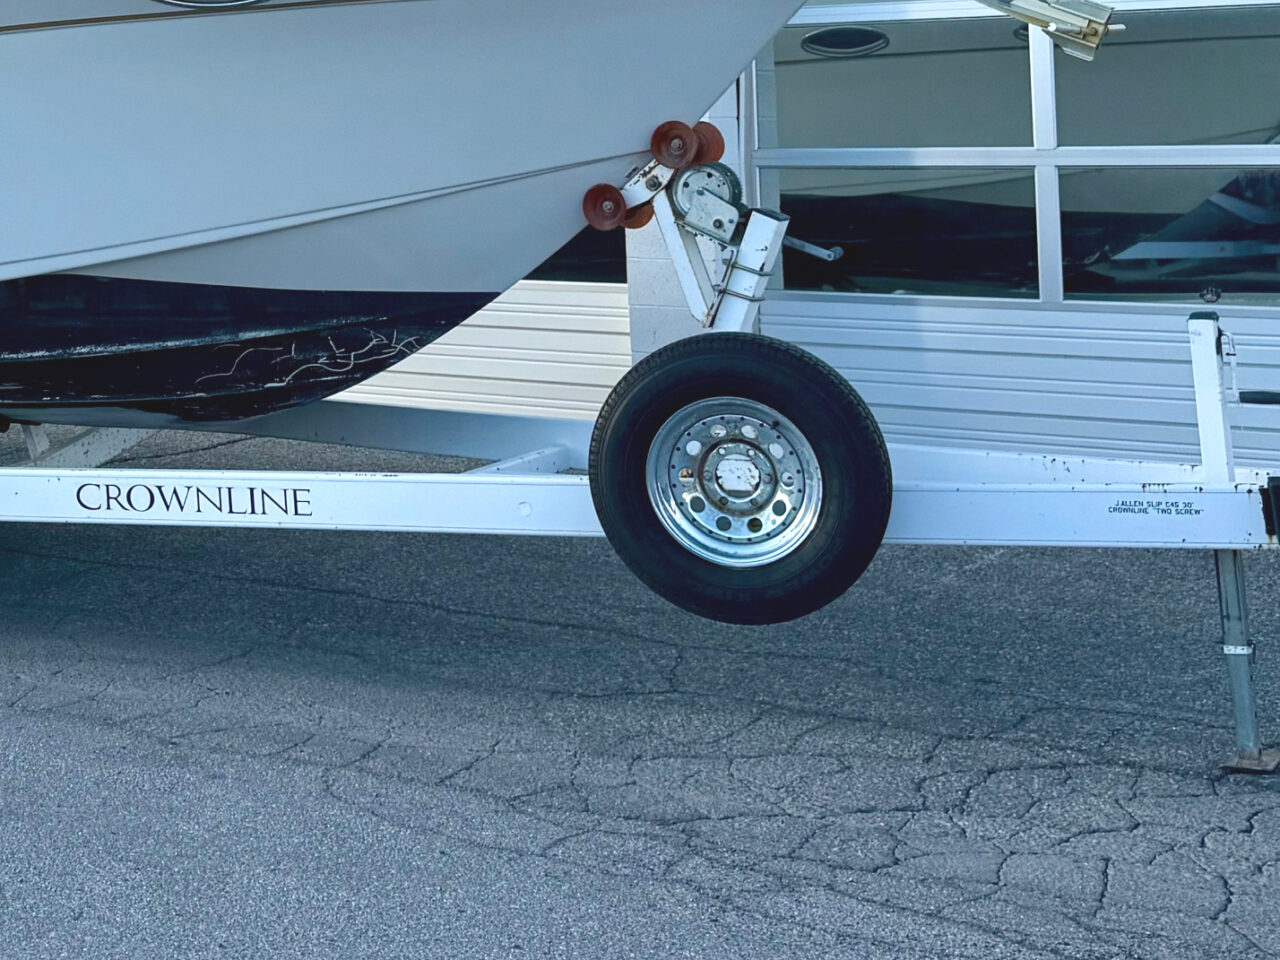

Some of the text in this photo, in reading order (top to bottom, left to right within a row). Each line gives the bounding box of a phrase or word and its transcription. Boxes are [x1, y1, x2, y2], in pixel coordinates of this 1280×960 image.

[76, 483, 313, 517] CROWNLINE
[1146, 500, 1163, 508] SLIP
[1108, 506, 1150, 515] CROWNLINE
